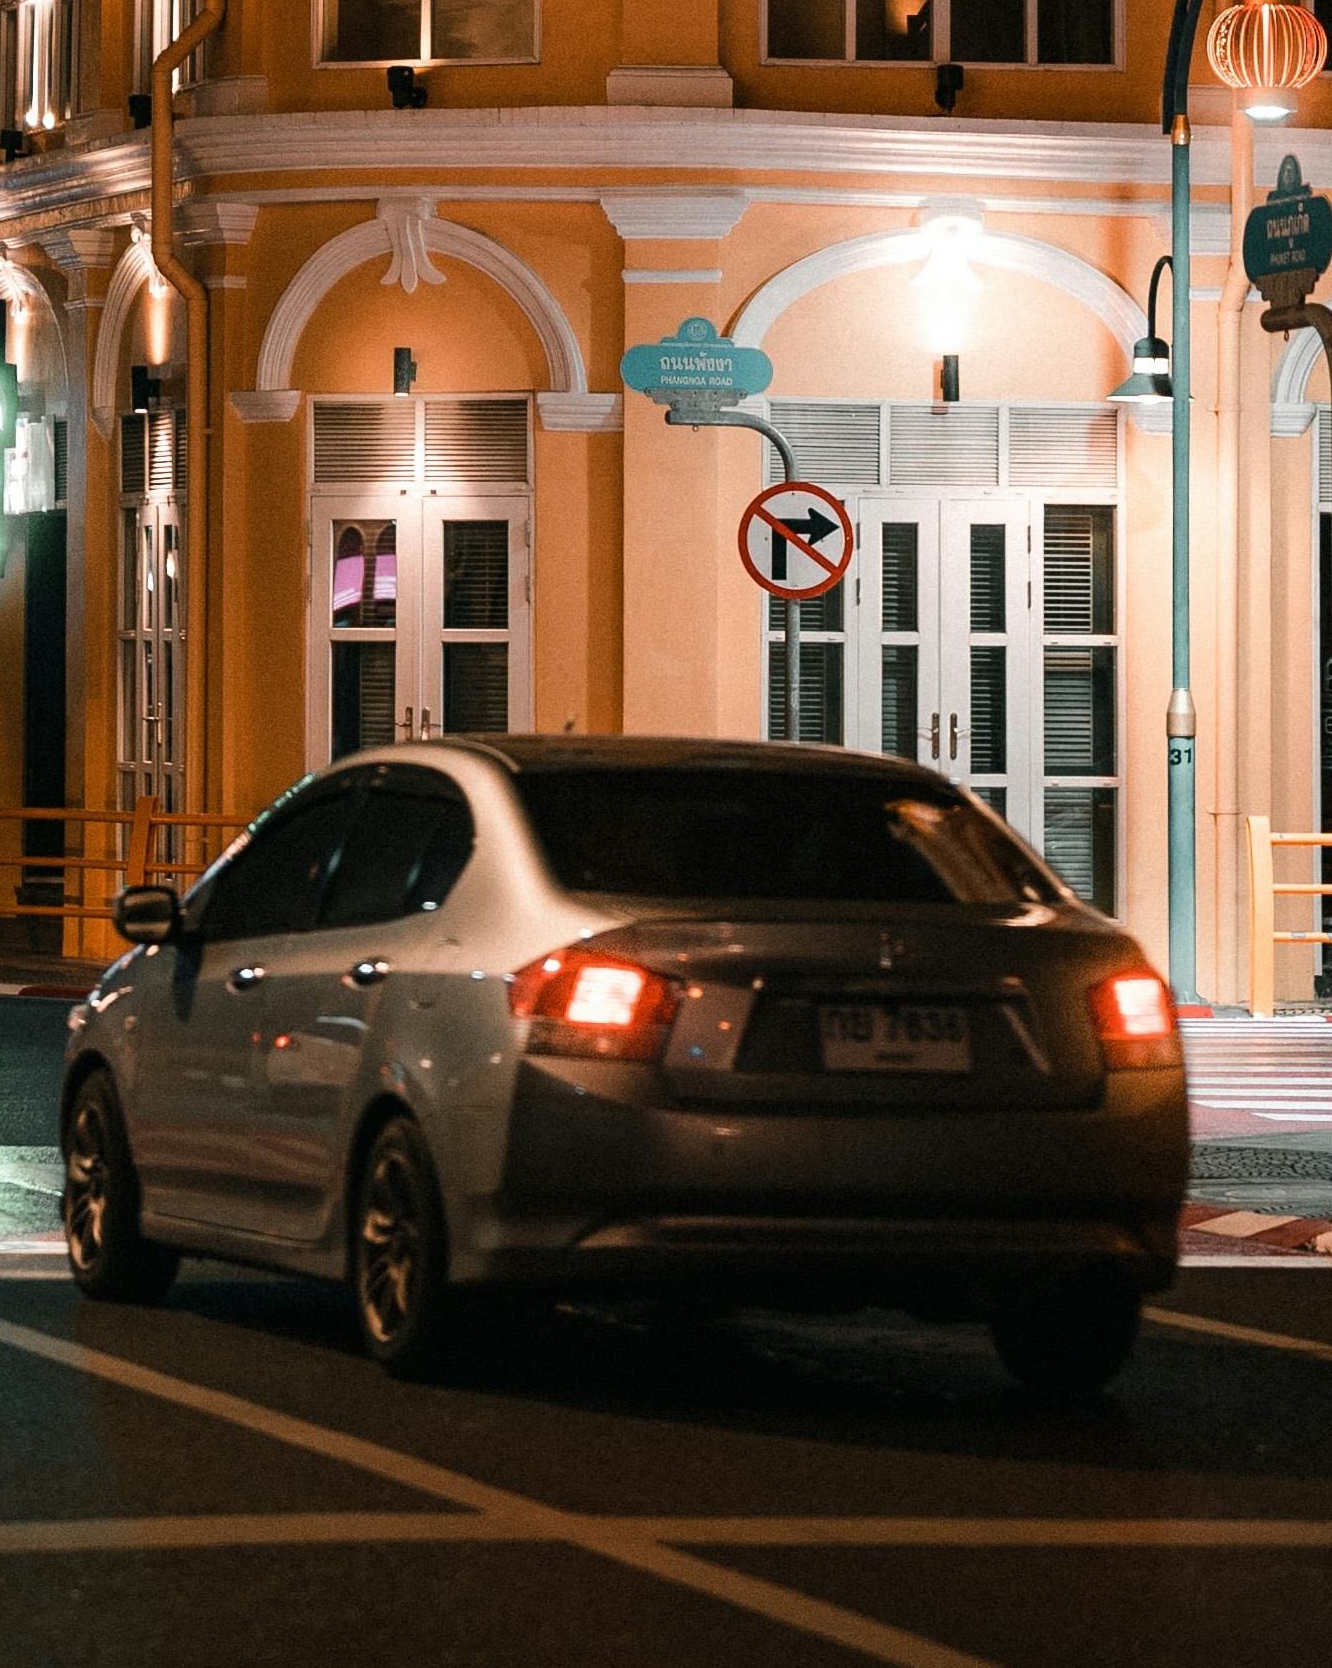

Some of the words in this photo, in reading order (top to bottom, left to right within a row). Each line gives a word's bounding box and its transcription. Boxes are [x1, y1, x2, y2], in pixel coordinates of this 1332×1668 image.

[660, 351, 733, 372] ถนนพังงา
[709, 376, 733, 386] ROAD
